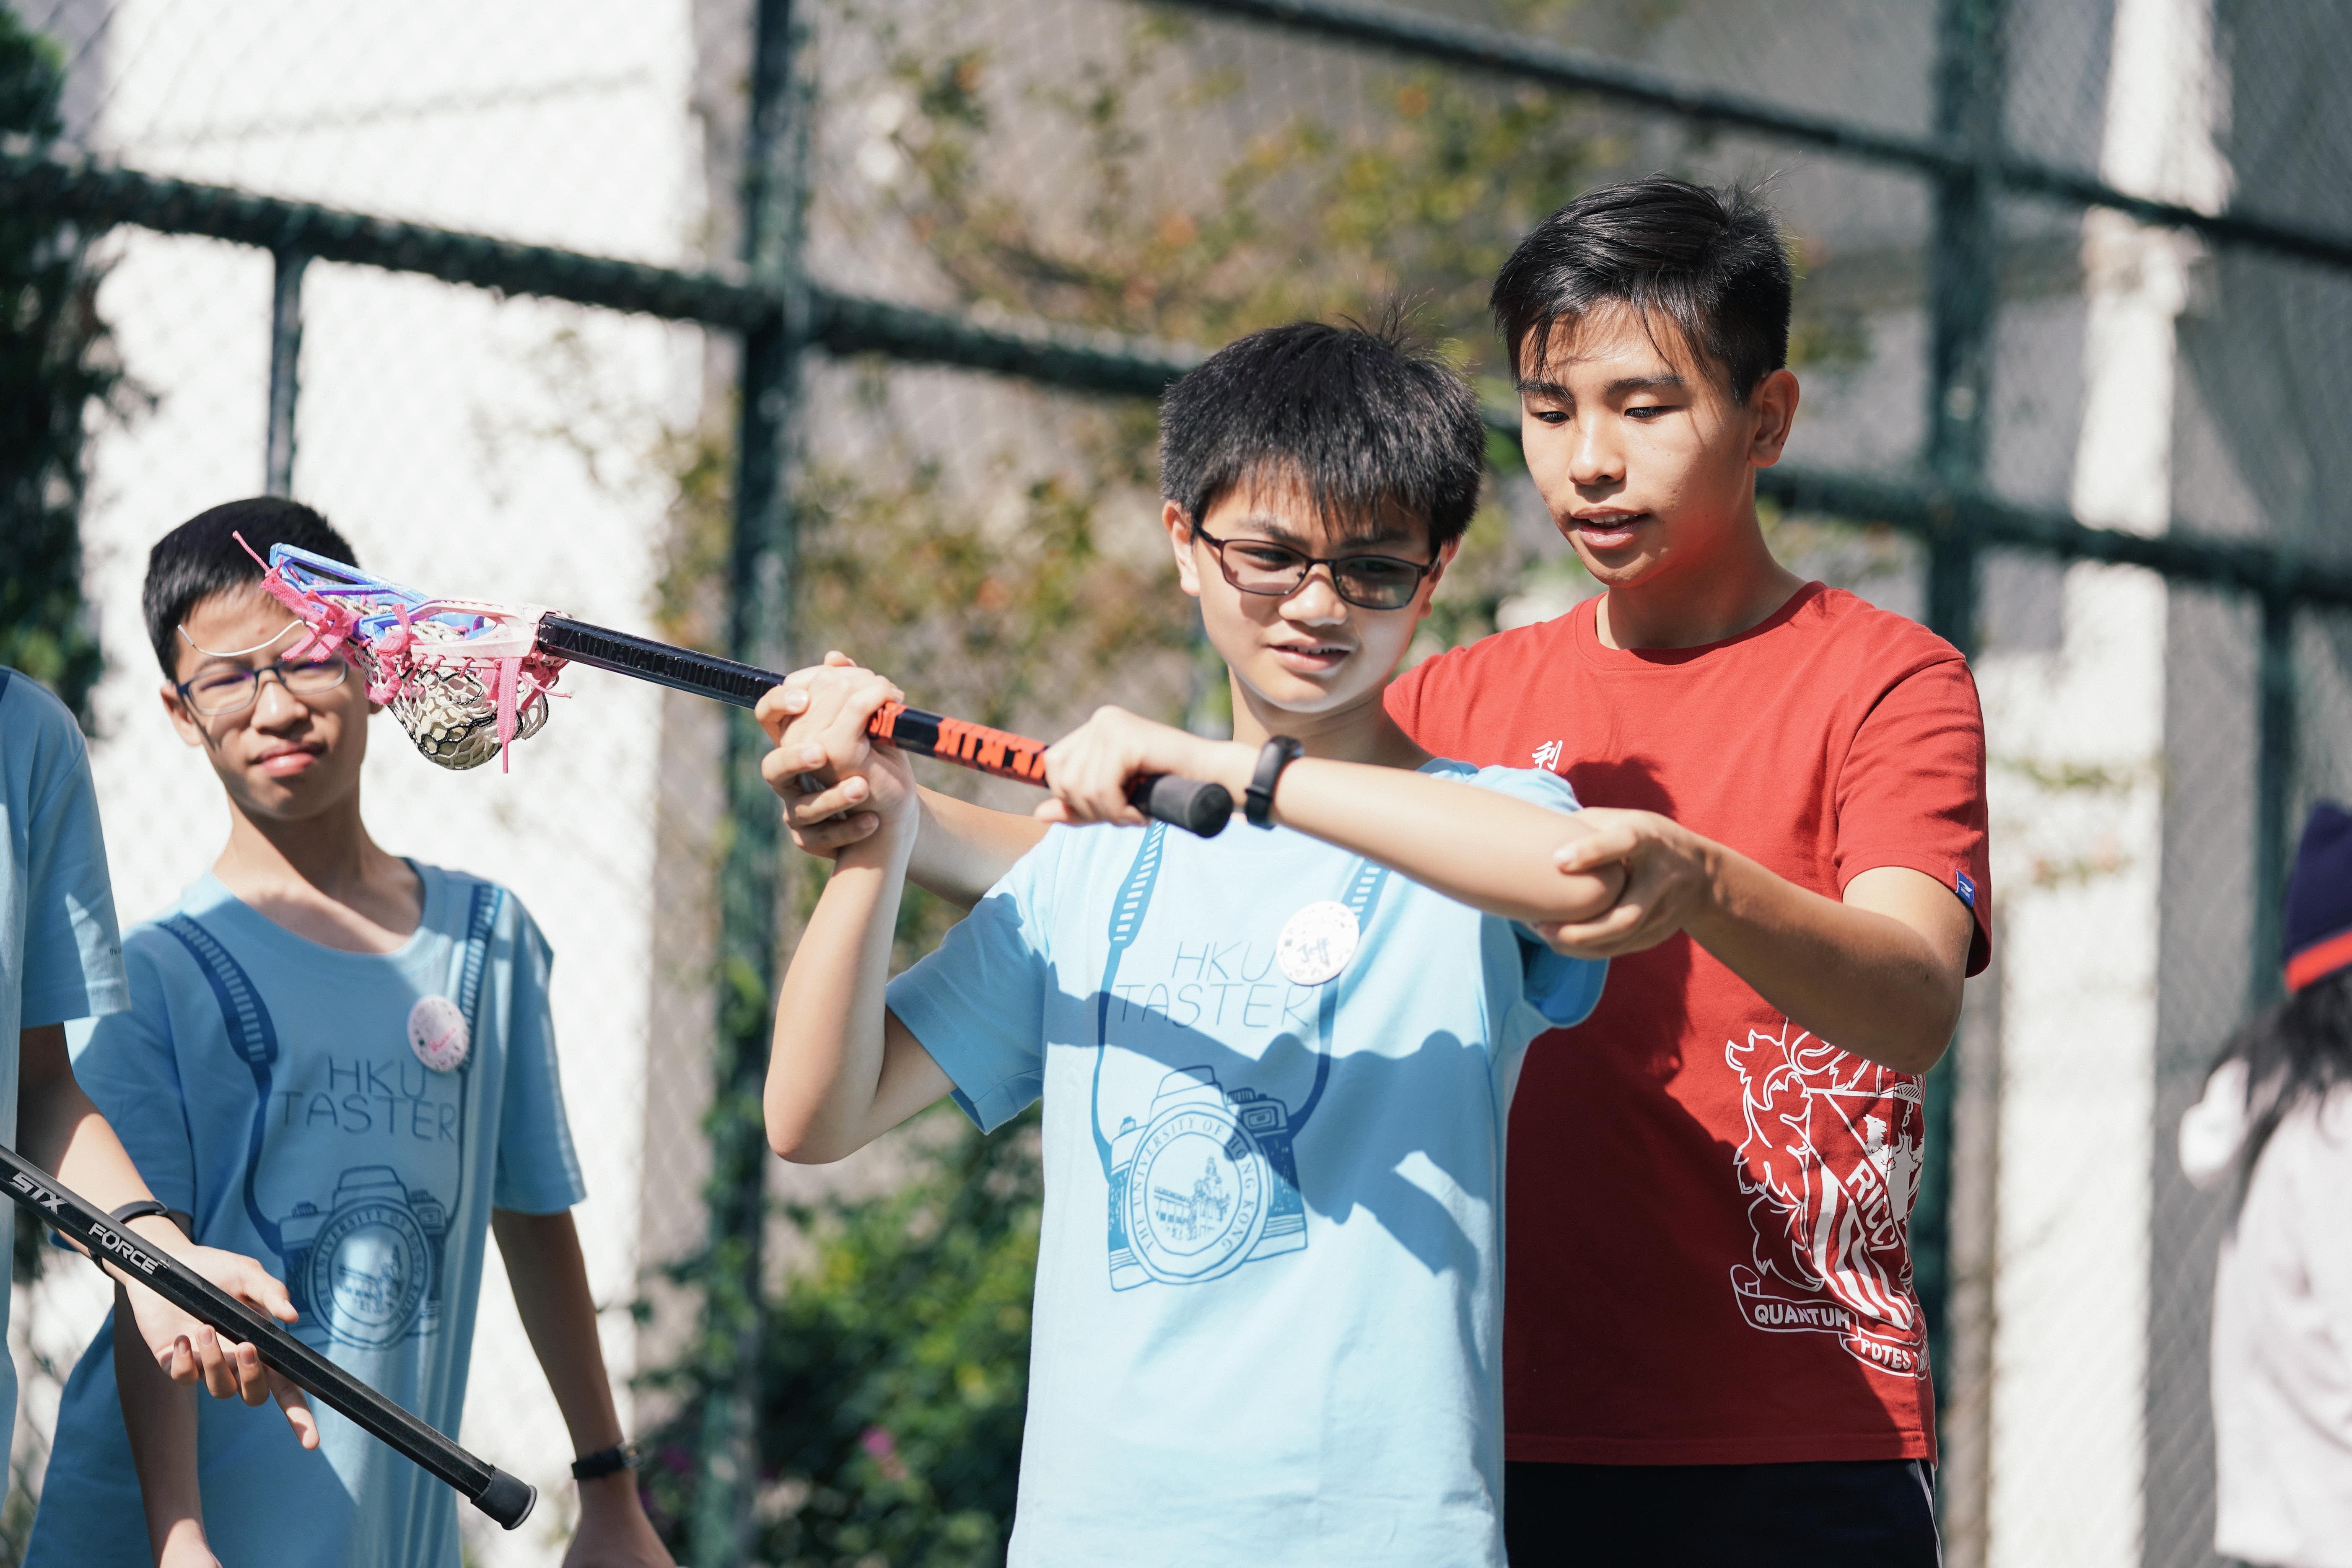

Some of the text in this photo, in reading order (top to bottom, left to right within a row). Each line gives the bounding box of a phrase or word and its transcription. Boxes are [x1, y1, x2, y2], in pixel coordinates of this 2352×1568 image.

[1532, 740, 1563, 771] 利
[1172, 941, 1276, 982] HKU
[1297, 937, 1331, 967] Jeff
[1116, 983, 1314, 1028] TASTER
[329, 1056, 426, 1099] HKU
[278, 1091, 457, 1144] TASTER
[9, 1171, 67, 1214] STX
[1133, 1117, 1256, 1252] THE UNIVERSITY OF HONG KONG
[1845, 1159, 1899, 1252] RICCI
[88, 1222, 159, 1275] FORCE
[1754, 1304, 1851, 1330] QUANTUM
[1860, 1338, 1911, 1370] POTES
